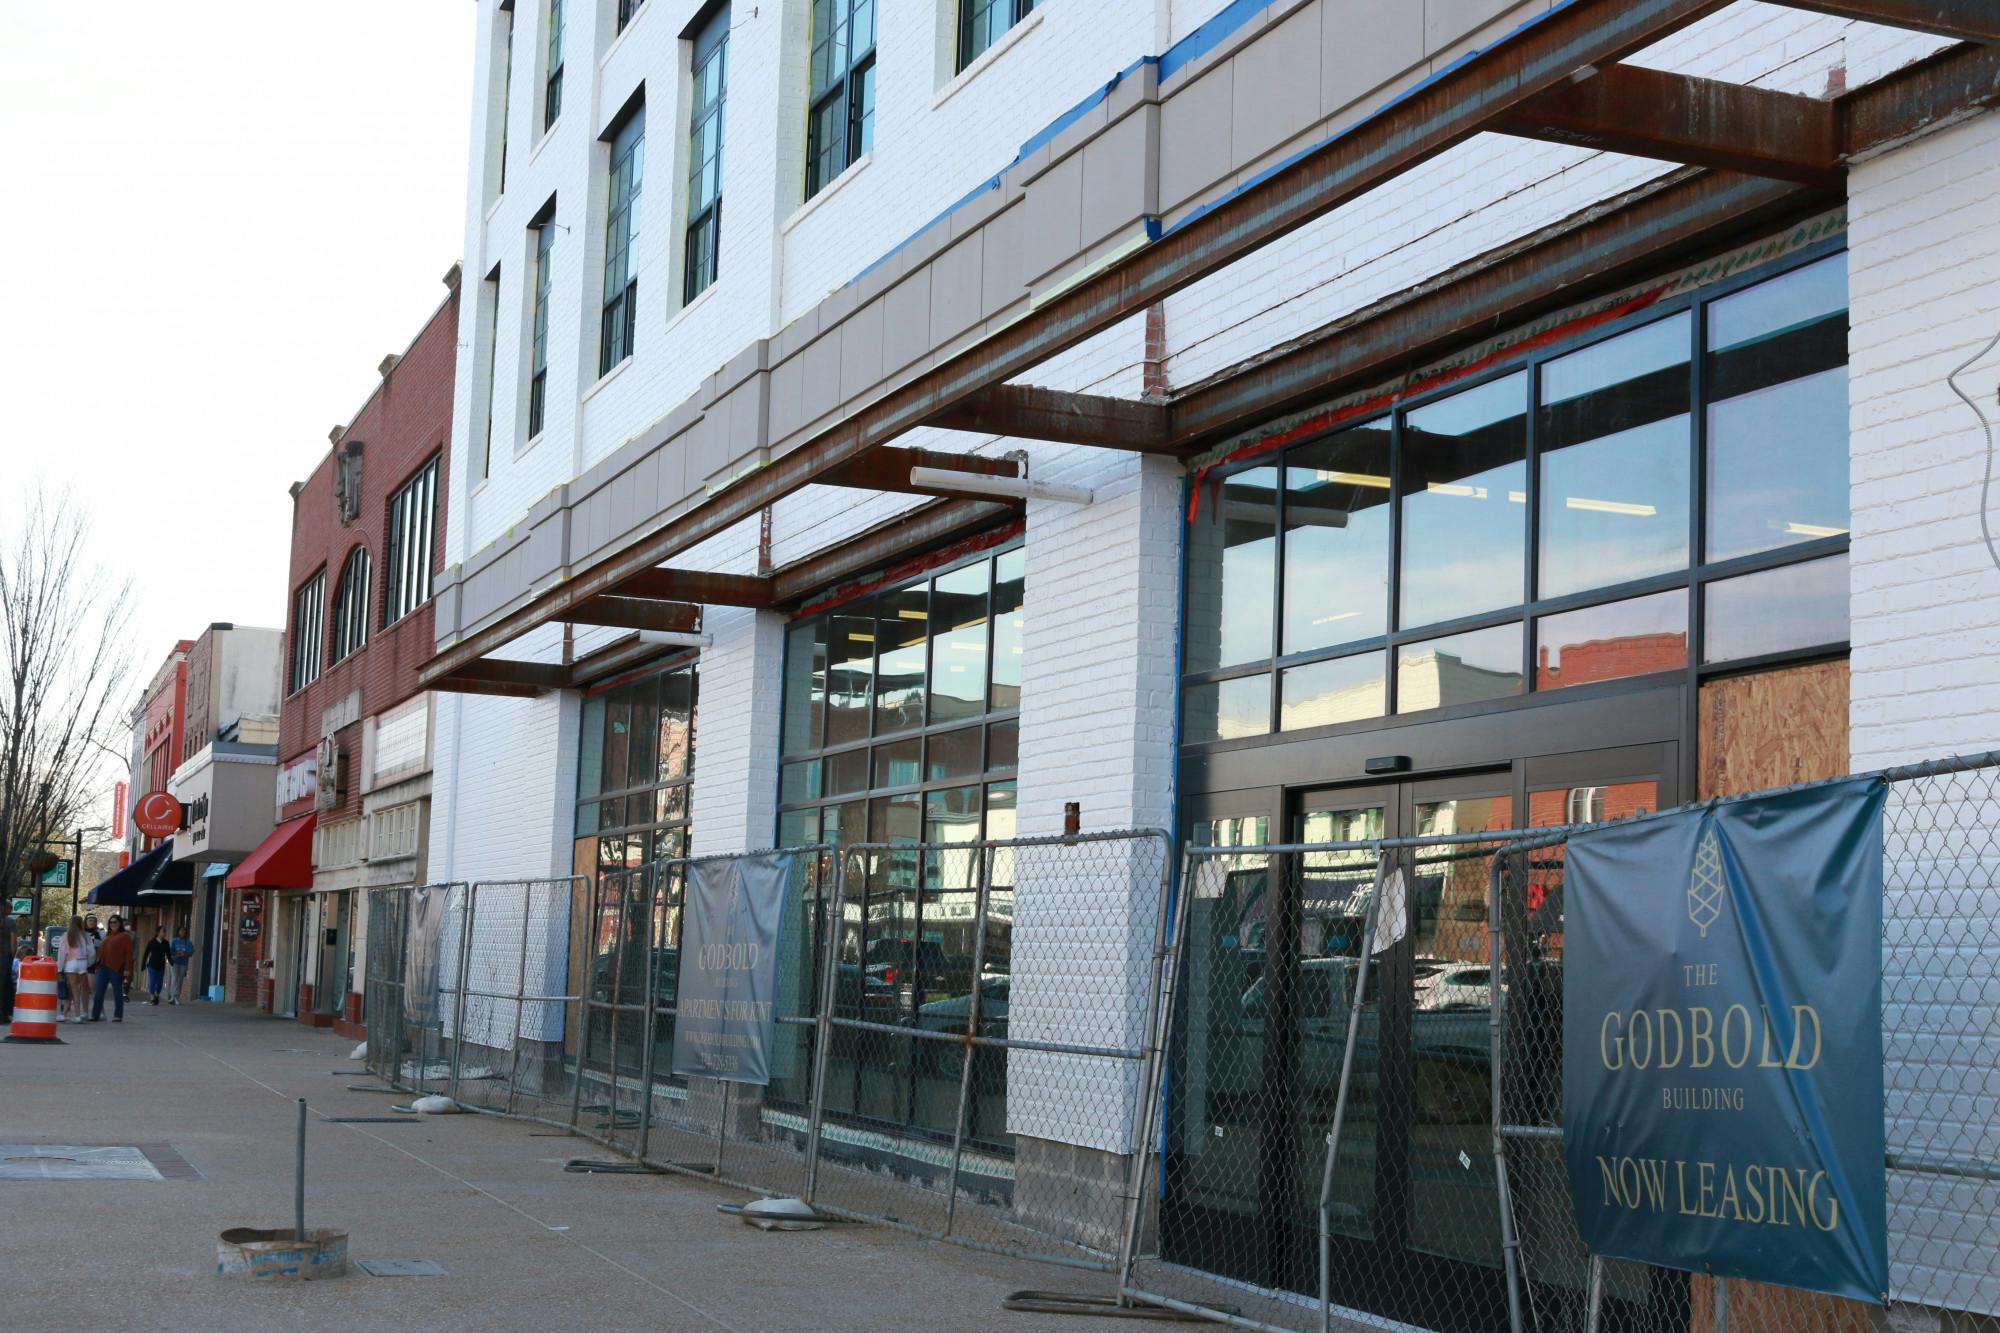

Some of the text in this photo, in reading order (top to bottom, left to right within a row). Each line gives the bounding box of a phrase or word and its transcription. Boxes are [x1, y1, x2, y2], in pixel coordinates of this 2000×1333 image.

[699, 943, 760, 970] GODBOLD
[1683, 963, 1718, 987] THE
[680, 999, 730, 1020] APARTMENS
[1600, 1003, 1823, 1071] GODBOLD
[1663, 1087, 1744, 1111] BUILDING
[1595, 1155, 1839, 1232] NOW LEASING
